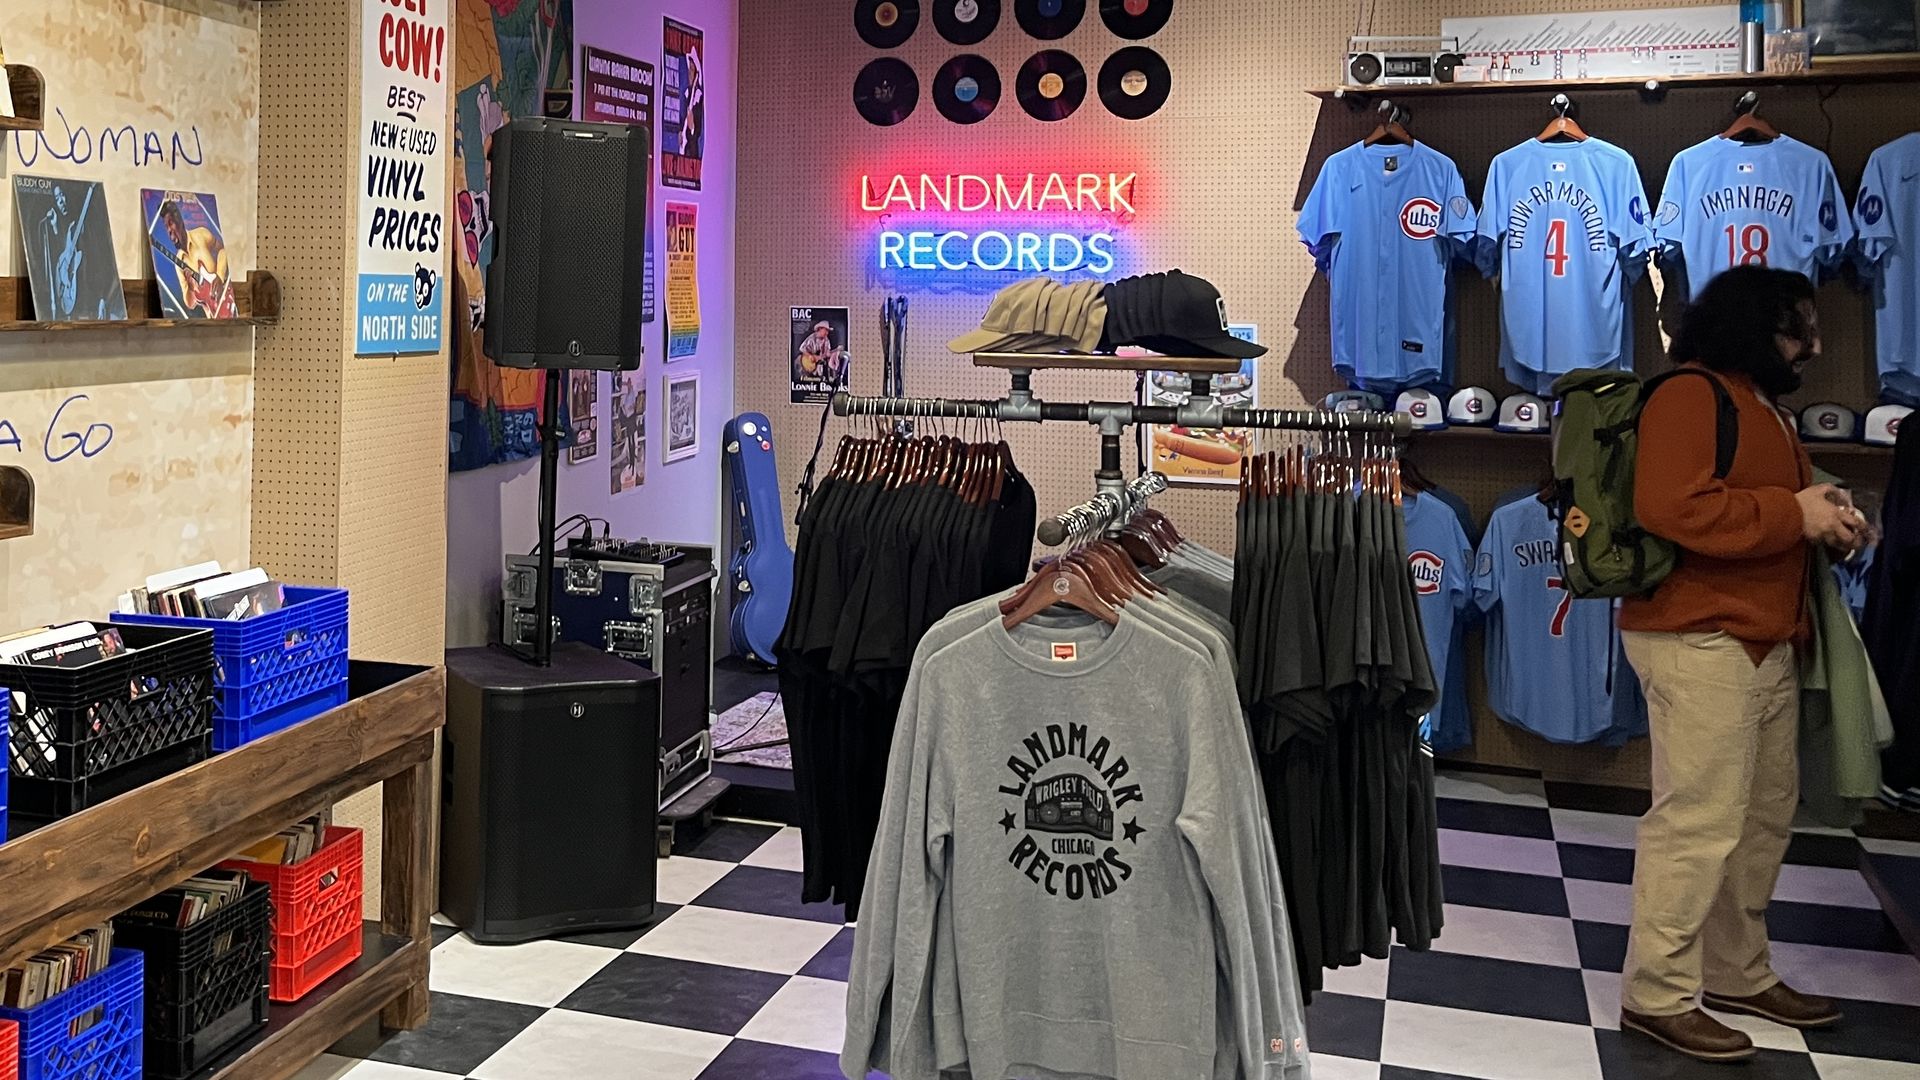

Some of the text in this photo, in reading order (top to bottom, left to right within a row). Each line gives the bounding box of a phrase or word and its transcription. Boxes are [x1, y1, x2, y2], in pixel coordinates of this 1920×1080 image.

[379, 12, 444, 83] COW!
[387, 85, 426, 112] BEST
[370, 120, 437, 156] NEW & USED
[367, 154, 425, 202] VINYL
[861, 172, 1137, 214] LANDMARK
[1700, 185, 1794, 220] IMANAGA
[368, 206, 441, 253] PRICES
[678, 227, 695, 253] GUY
[1544, 219, 1569, 277] 4
[1724, 223, 1769, 268] 18
[879, 231, 1115, 274] RECORDS
[367, 283, 409, 303] ON THE
[362, 315, 437, 341] NORTH SIDE
[791, 308, 812, 319] BAC
[1514, 540, 1557, 568] SWA
[1546, 576, 1572, 637] 7
[998, 722, 1144, 809] LANDMARK
[1035, 777, 1104, 812] WRIGLEY FIELD
[1051, 838, 1096, 856] CHICAGO
[1008, 834, 1133, 900] RECORDS
